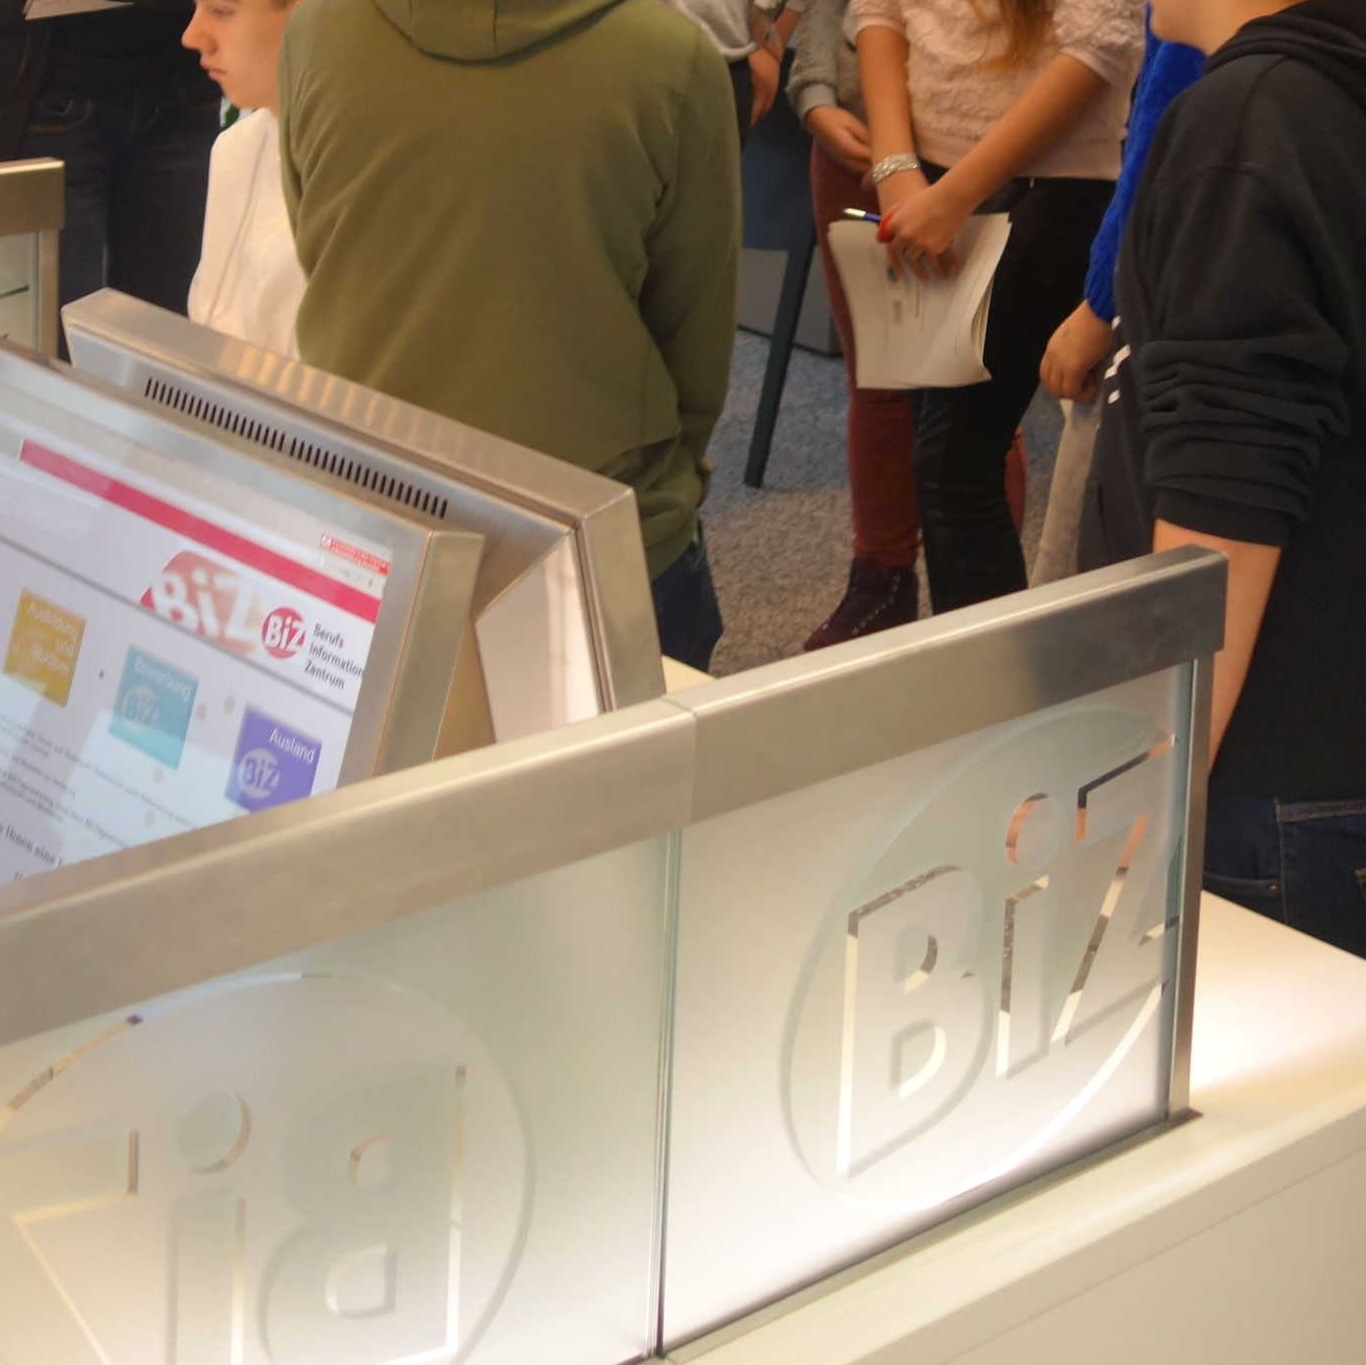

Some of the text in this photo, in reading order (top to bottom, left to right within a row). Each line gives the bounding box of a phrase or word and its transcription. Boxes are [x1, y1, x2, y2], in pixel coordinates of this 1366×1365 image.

[27, 601, 79, 639] Ausbildung
[151, 566, 262, 641] BiZ
[55, 639, 76, 659] und
[265, 612, 306, 653] BiZ
[313, 622, 344, 649] Berufs
[132, 654, 192, 703] Bewerbung
[304, 658, 345, 691] Zentrum
[268, 727, 316, 765] Ausland
[242, 753, 282, 789] BiZ
[5, 823, 34, 853] Ihnen
[837, 734, 1177, 1180] BiZ
